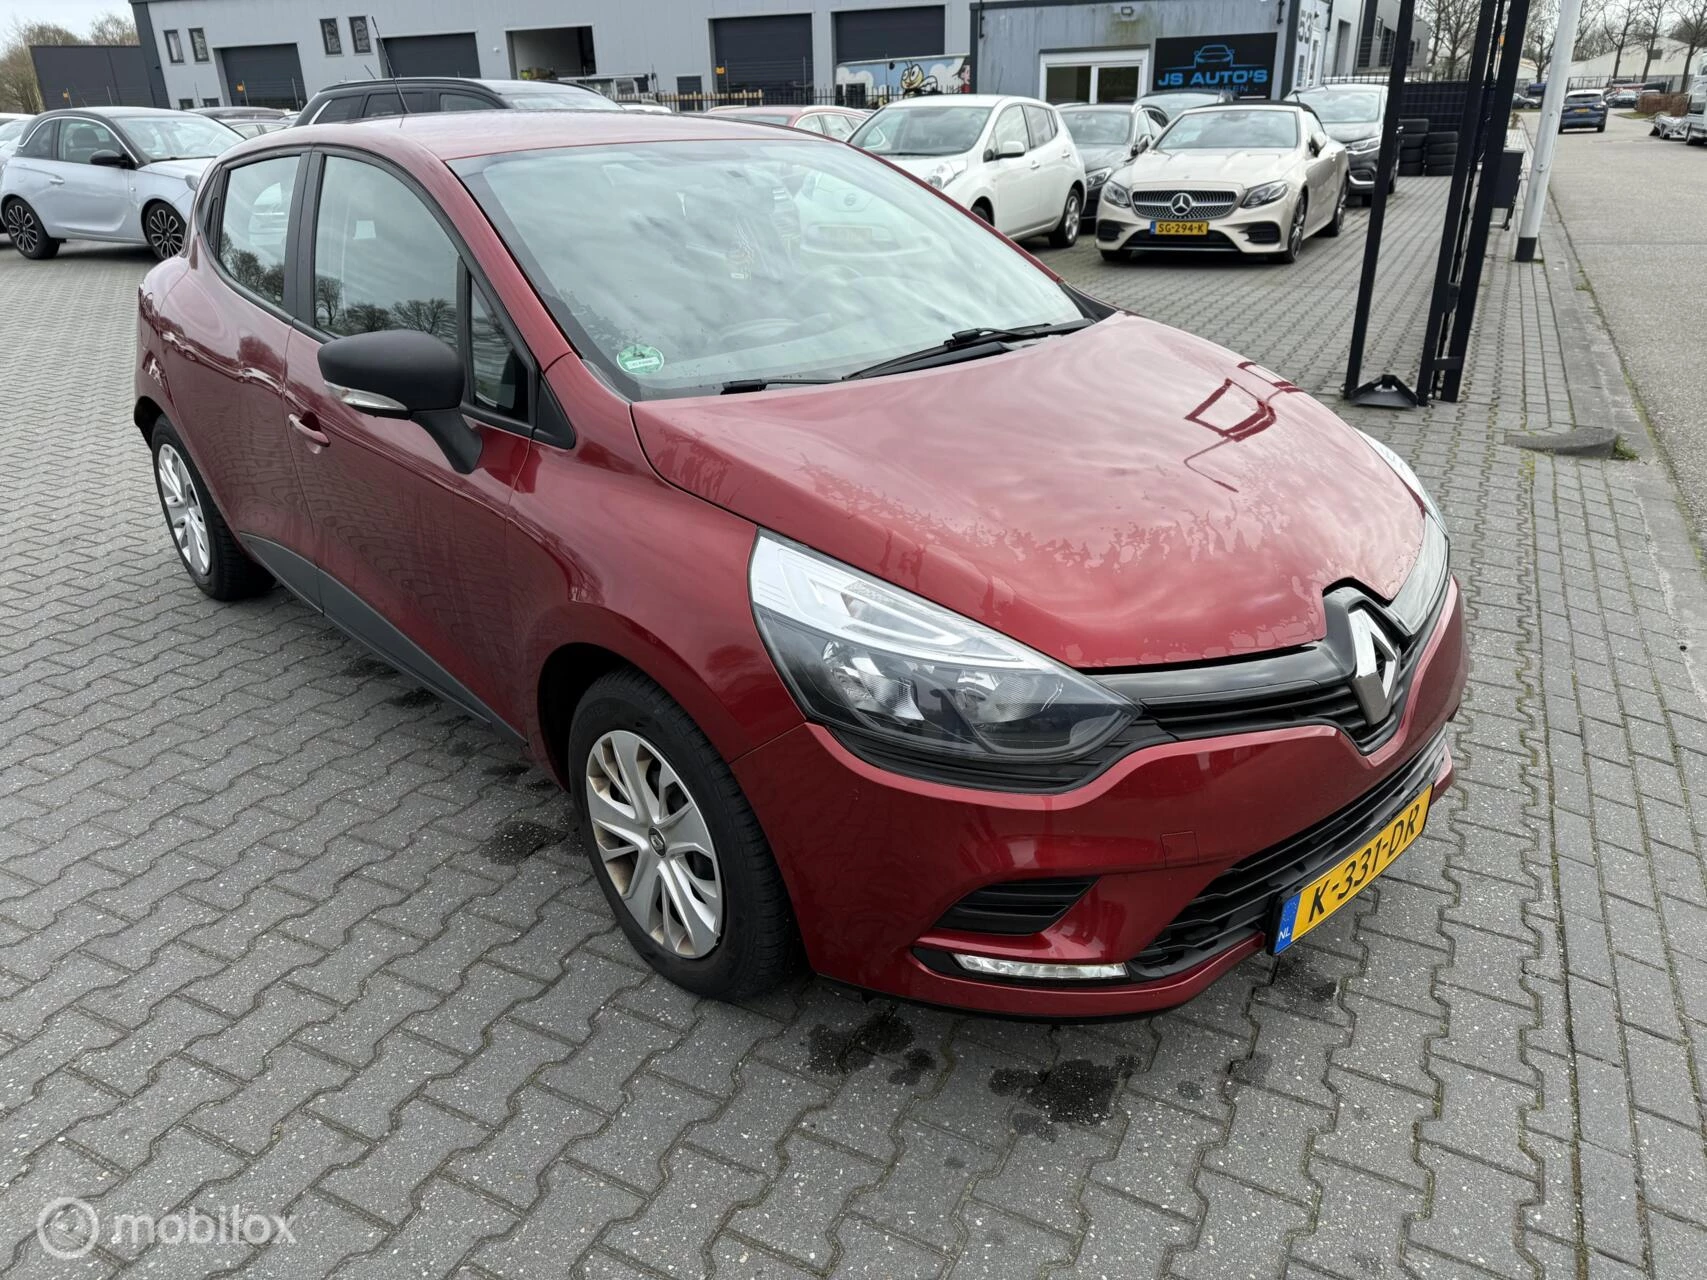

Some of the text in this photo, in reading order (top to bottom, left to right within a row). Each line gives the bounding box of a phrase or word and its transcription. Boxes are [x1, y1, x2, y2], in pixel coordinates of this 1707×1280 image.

[1158, 69, 1268, 86] JS AUTO'S
[1158, 223, 1204, 233] SG-294-K
[1308, 803, 1420, 923] K-331-DR
[1278, 926, 1291, 942] NL
